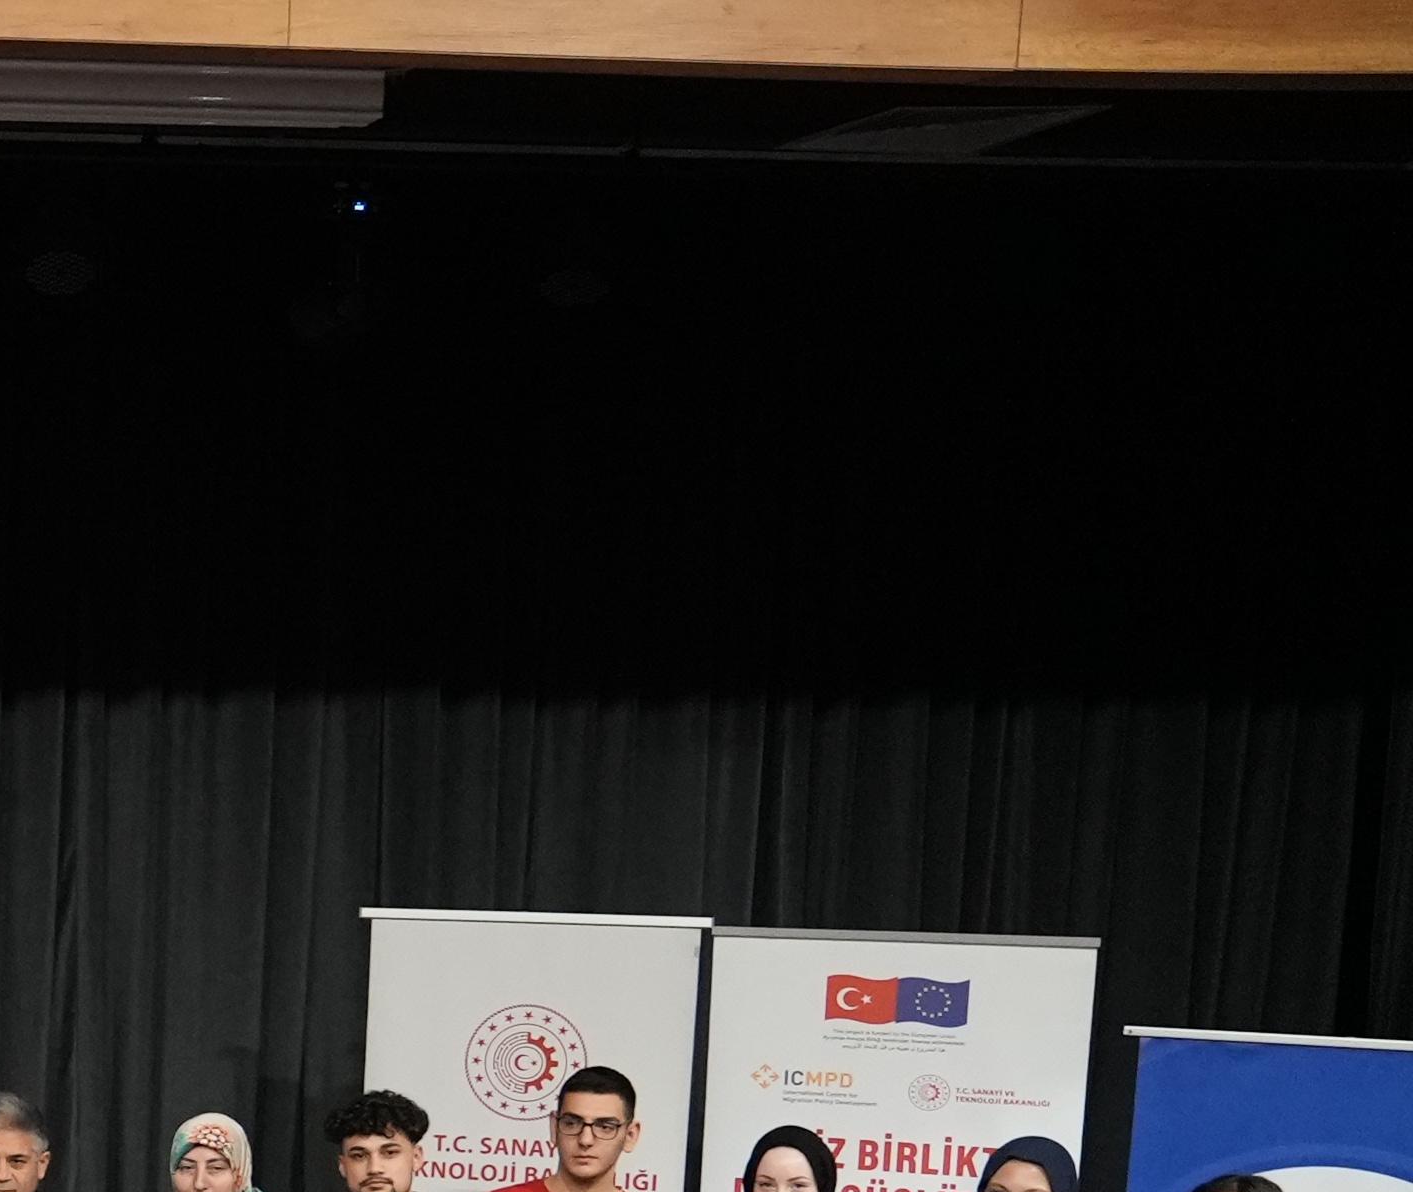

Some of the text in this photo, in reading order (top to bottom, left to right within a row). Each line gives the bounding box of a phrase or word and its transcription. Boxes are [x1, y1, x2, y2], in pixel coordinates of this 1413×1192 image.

[784, 1069, 853, 1088] ICMPD
[434, 1134, 558, 1158] T.C. SANAY
[415, 1161, 516, 1182] KNOLOJİ
